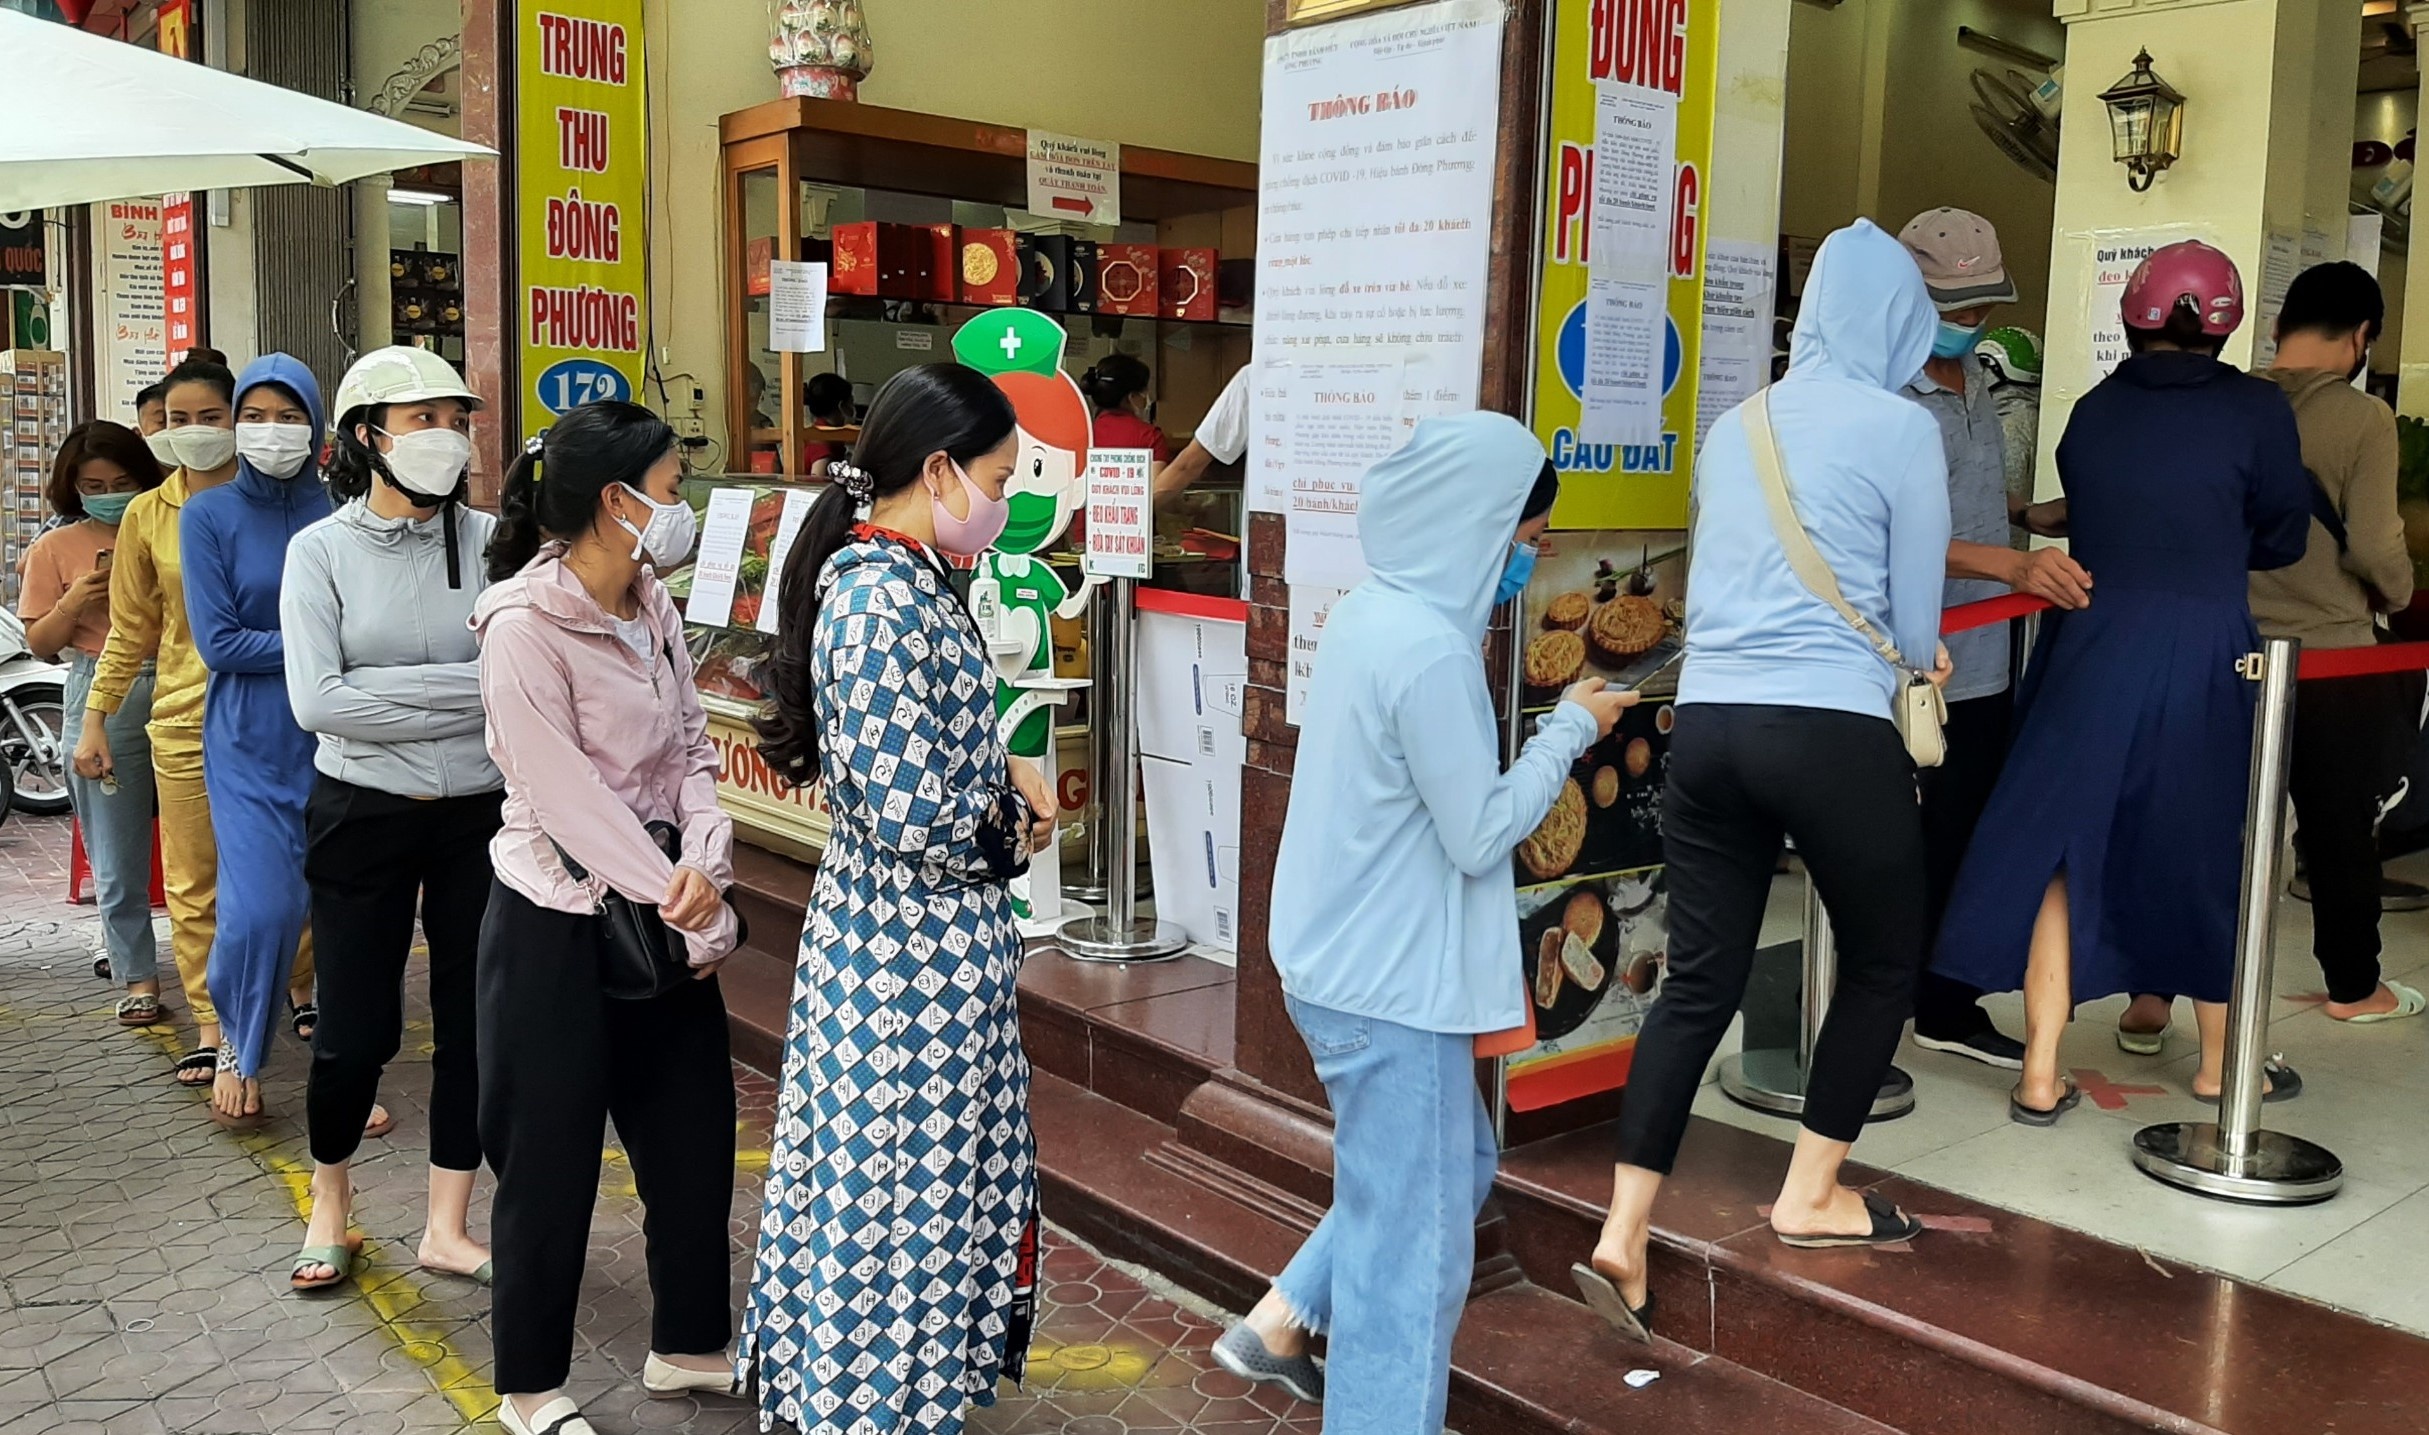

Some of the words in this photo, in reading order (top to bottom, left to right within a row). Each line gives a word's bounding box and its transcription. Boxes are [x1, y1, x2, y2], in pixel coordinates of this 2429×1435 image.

[538, 12, 626, 85] TRUNG
[1307, 94, 1371, 122] THÔNG
[1376, 85, 1418, 113] BÁO
[558, 109, 608, 172] THU
[1320, 170, 1350, 184] COVID
[111, 201, 158, 220] BÌNH
[548, 189, 620, 262] ĐÔNG
[2097, 249, 2117, 262] Quý
[2099, 271, 2121, 283] đeo
[531, 286, 637, 350] PHƯƠNG
[2093, 331, 2120, 342] theo
[2096, 350, 2117, 362] khi
[553, 370, 618, 410] 172
[1314, 389, 1351, 404] THÔNG
[1353, 389, 1376, 404] BÁO
[1100, 467, 1120, 478] COVID
[1127, 467, 1134, 478] 19
[707, 731, 791, 801] ƯƠNG
